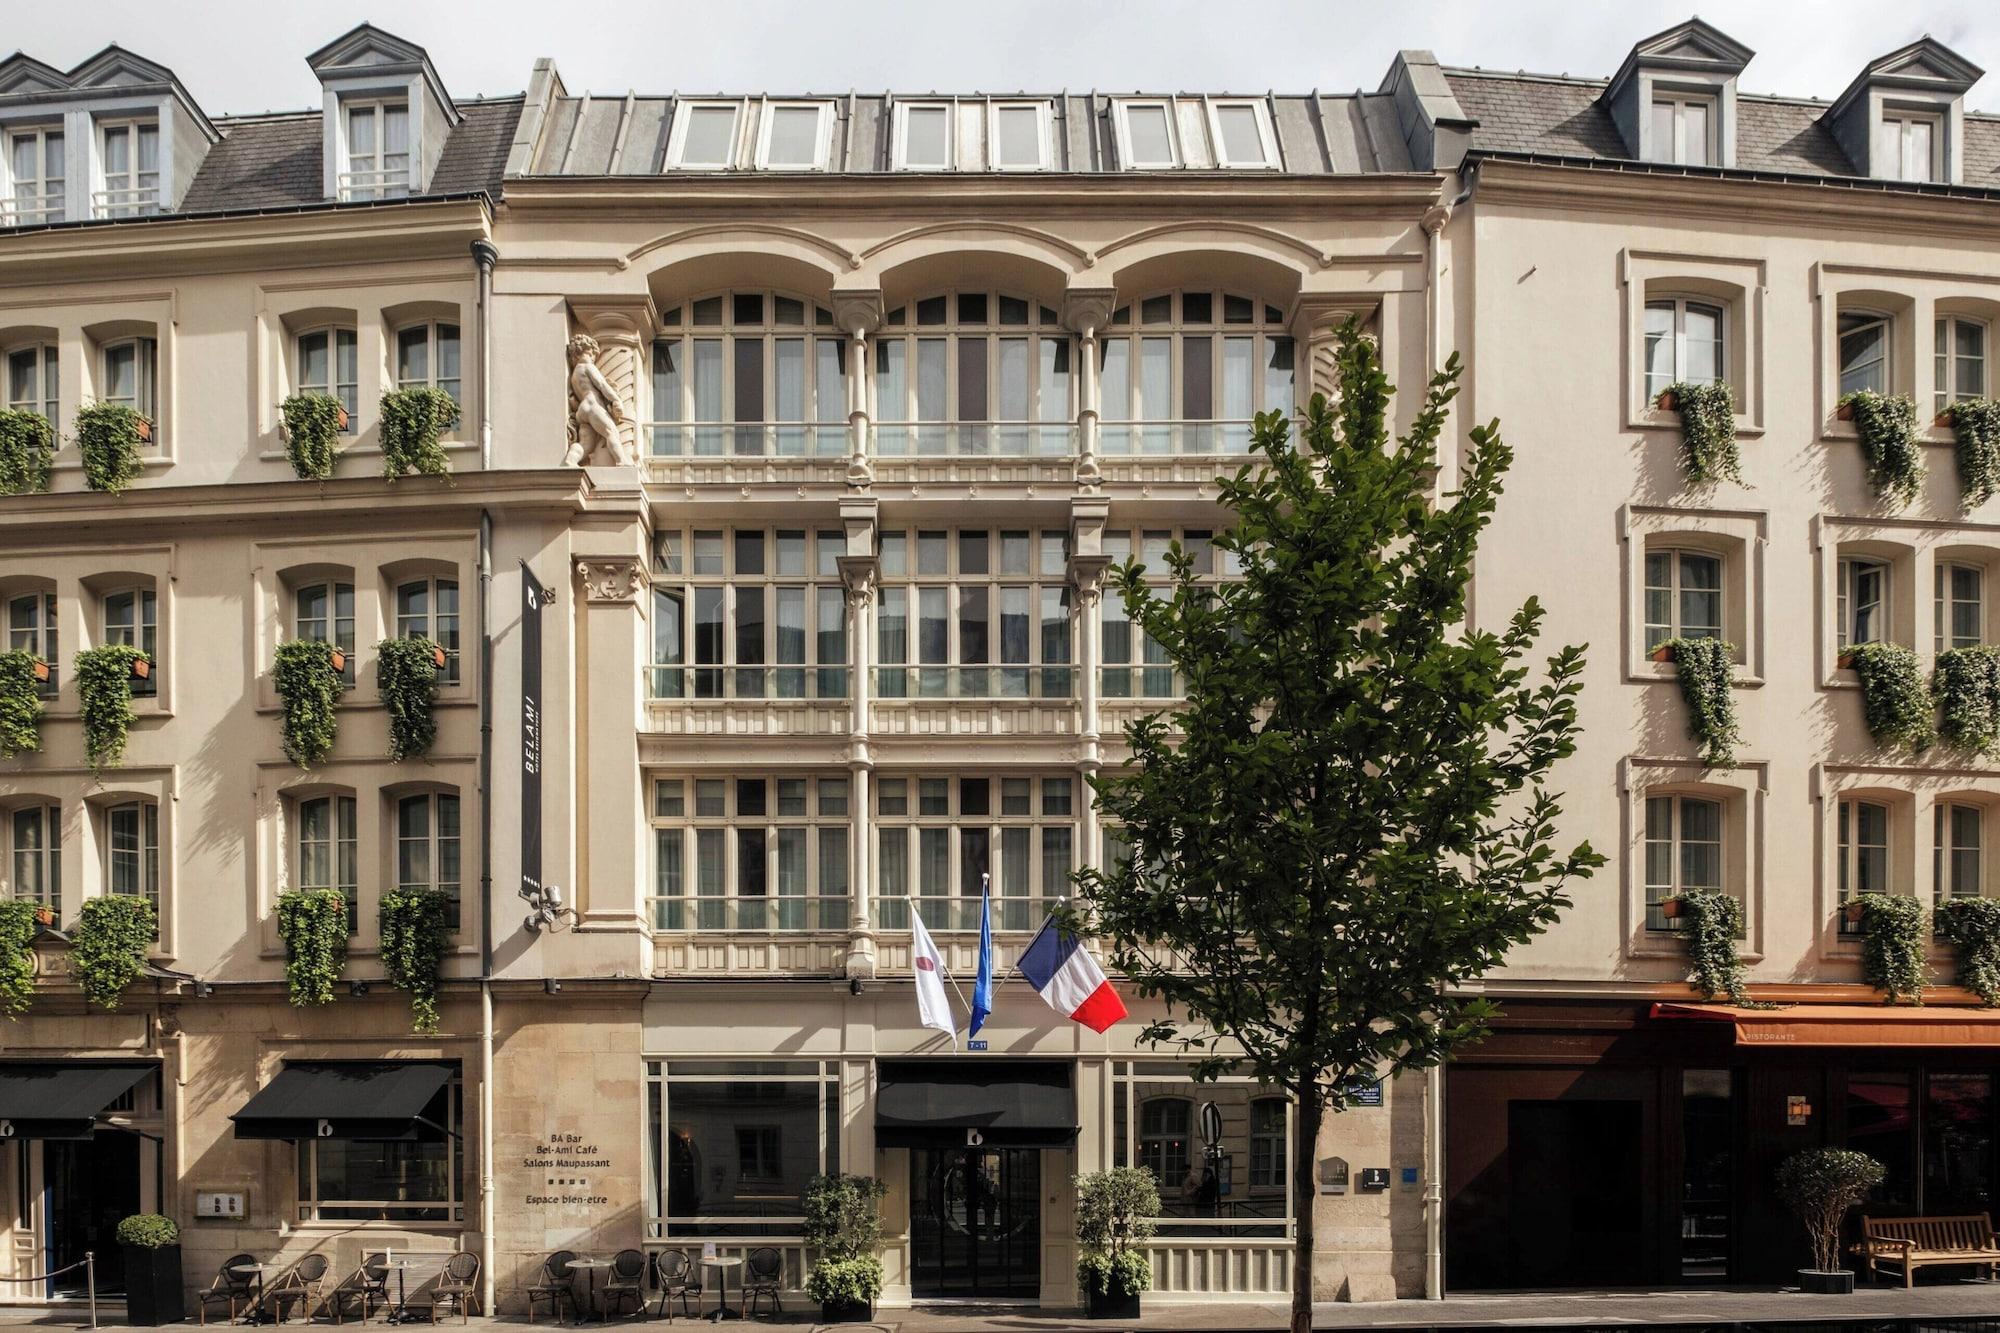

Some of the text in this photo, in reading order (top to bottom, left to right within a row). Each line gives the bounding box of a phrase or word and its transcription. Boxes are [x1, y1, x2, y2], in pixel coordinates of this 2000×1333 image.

[525, 695, 535, 774] BELAMI
[551, 1134, 583, 1143] BA Bar
[575, 1145, 598, 1154] Café
[523, 1158, 611, 1169] Salons Maupassant
[525, 1195, 560, 1206] Espace
